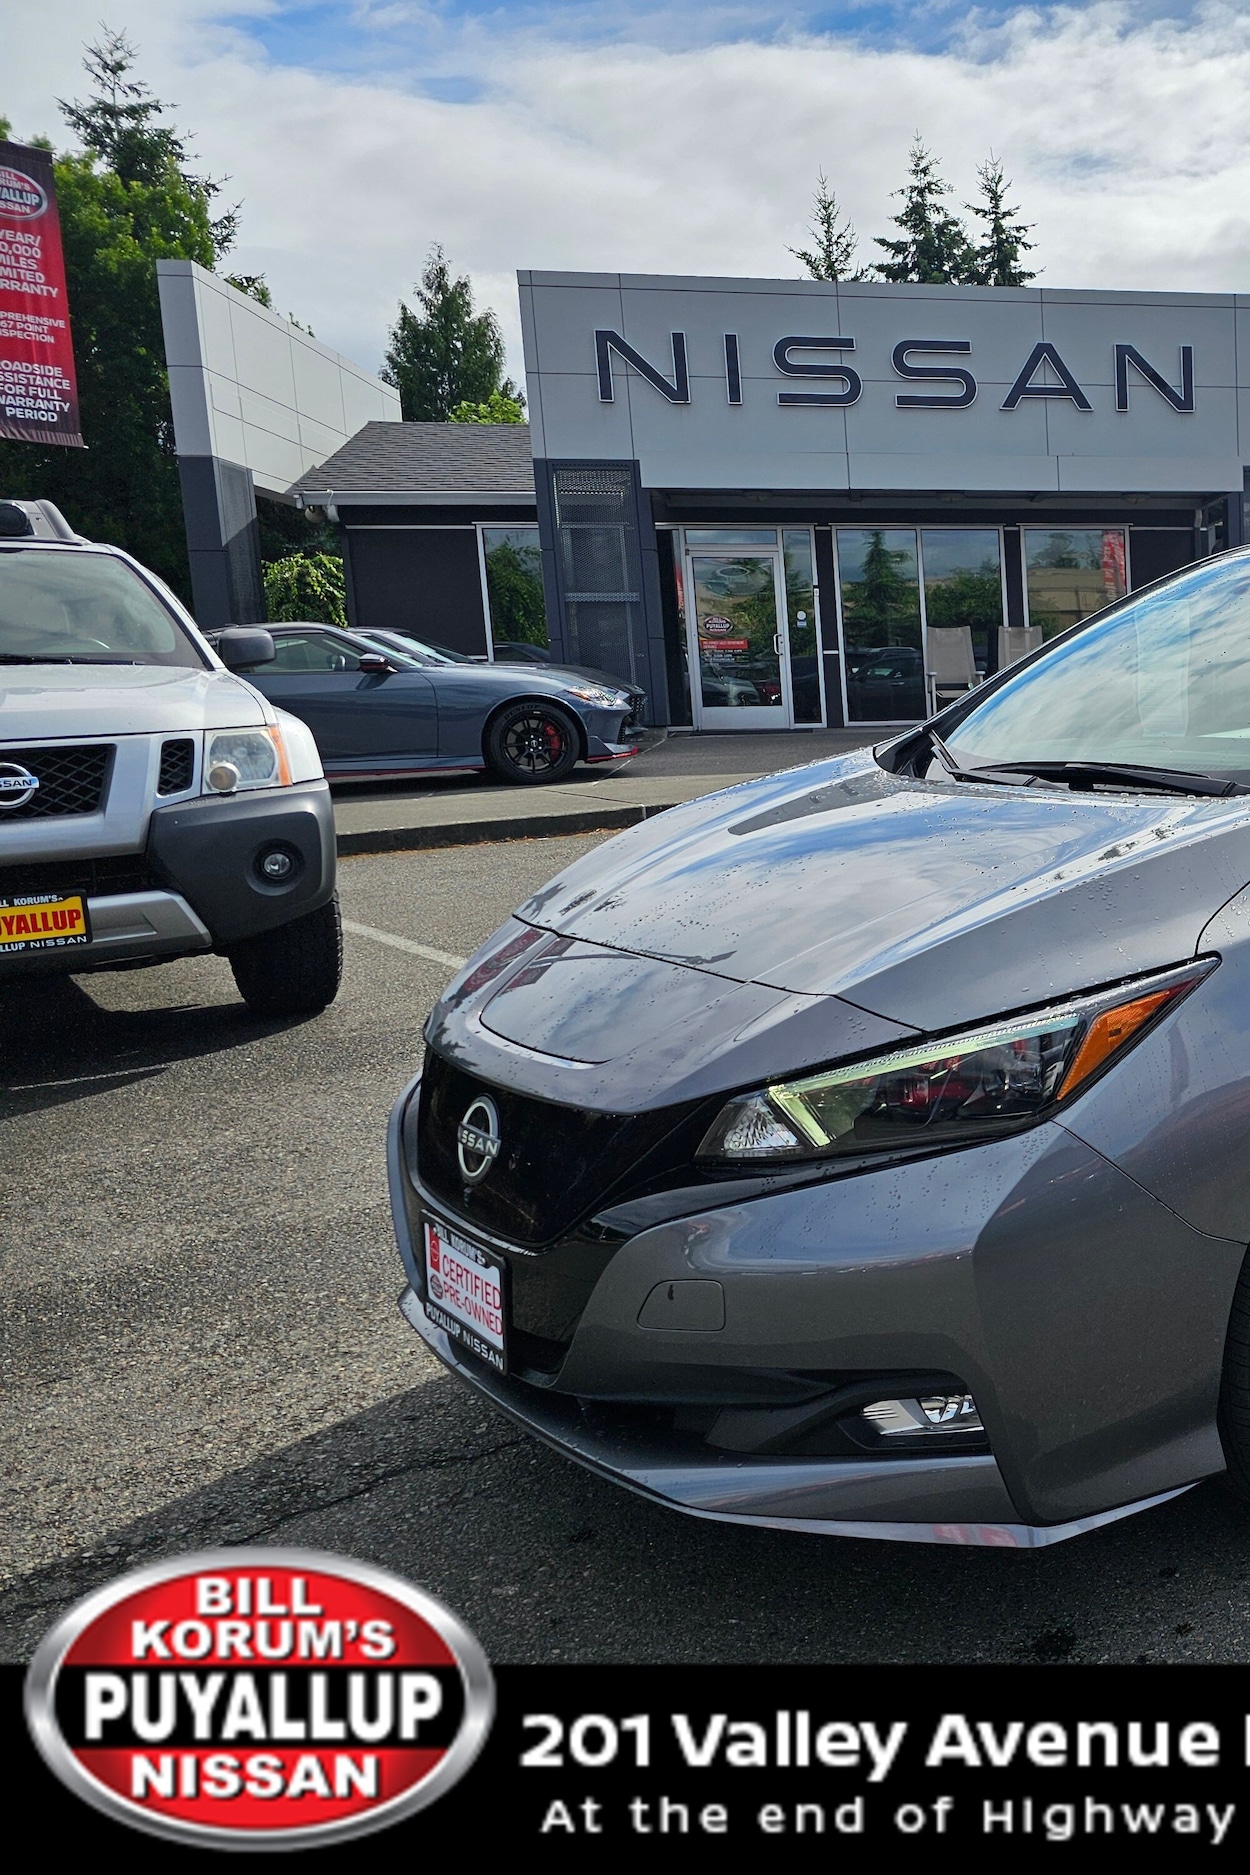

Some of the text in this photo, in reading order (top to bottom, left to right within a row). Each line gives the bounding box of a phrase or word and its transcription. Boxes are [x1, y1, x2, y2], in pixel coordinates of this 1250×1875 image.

[0, 170, 17, 181] ILL
[0, 186, 40, 206] ALLUP
[0, 328, 55, 344] SPECTION
[16, 321, 49, 334] POINT
[0, 359, 63, 378] OADSIDE
[594, 328, 1196, 413] NISSAN
[28, 385, 62, 400] FULL
[5, 406, 58, 423] PERIOD
[0, 779, 32, 789] SAN
[13, 894, 58, 906] KORUM'S
[0, 908, 82, 937] YALLUP
[0, 935, 88, 953] LLUP NISSAN
[461, 1129, 499, 1156] SSAN
[442, 1254, 502, 1311] CERTIFIED
[443, 1280, 503, 1336] PRE-OWNED
[425, 1301, 504, 1371] PUYALLUP NISSAN
